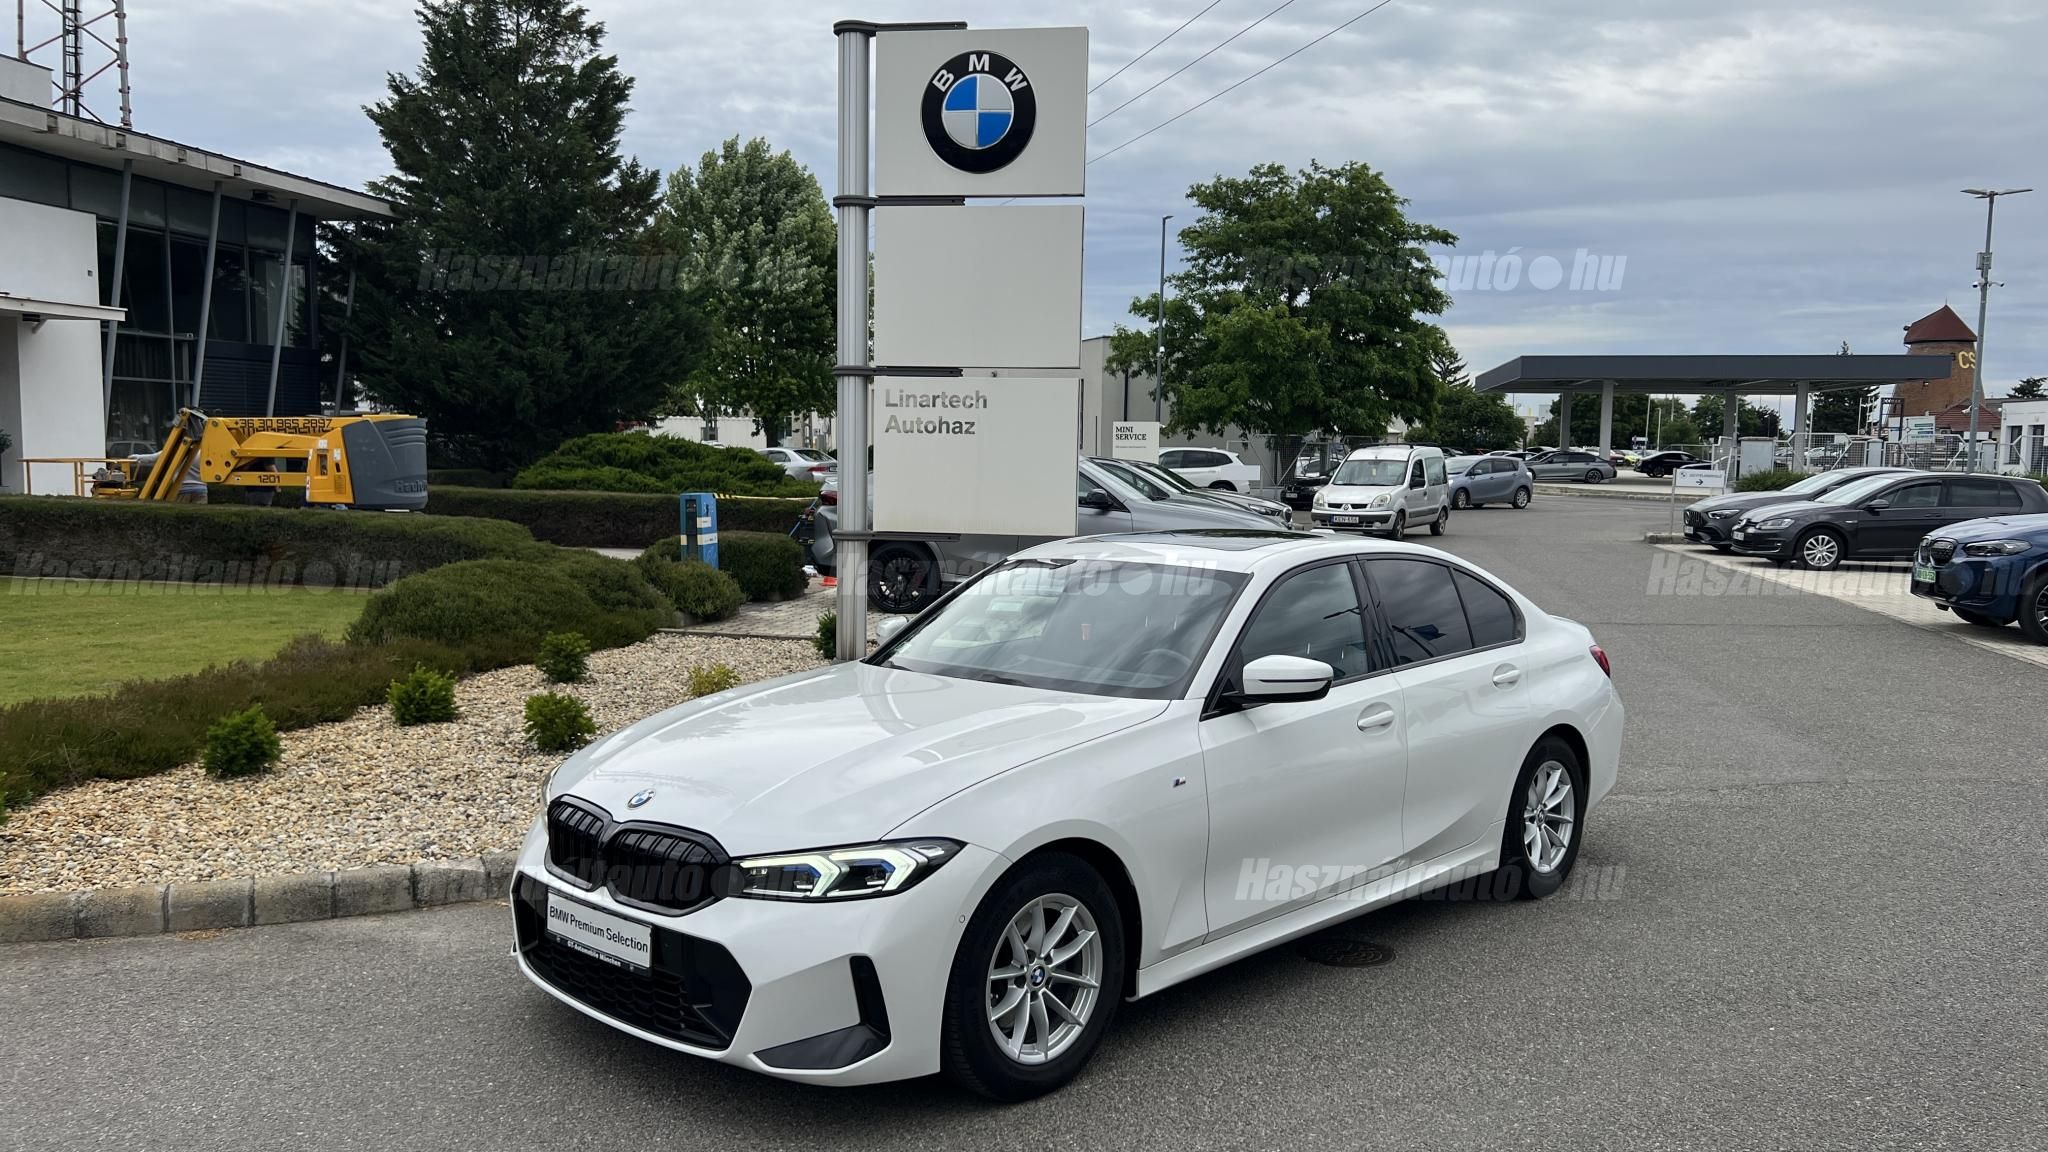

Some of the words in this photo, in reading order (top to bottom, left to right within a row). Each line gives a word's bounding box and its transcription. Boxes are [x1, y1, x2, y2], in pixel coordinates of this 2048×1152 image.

[932, 53, 1028, 93] BMW
[885, 389, 988, 408] Linartech
[234, 418, 255, 429] +36
[258, 418, 273, 429] 30
[276, 418, 300, 429] 965
[303, 418, 332, 429] 2897
[884, 414, 976, 434] Autohaz
[257, 474, 281, 484] 1201
[549, 906, 570, 924] BMW
[570, 914, 605, 938] Premium
[606, 928, 648, 953] Selection
